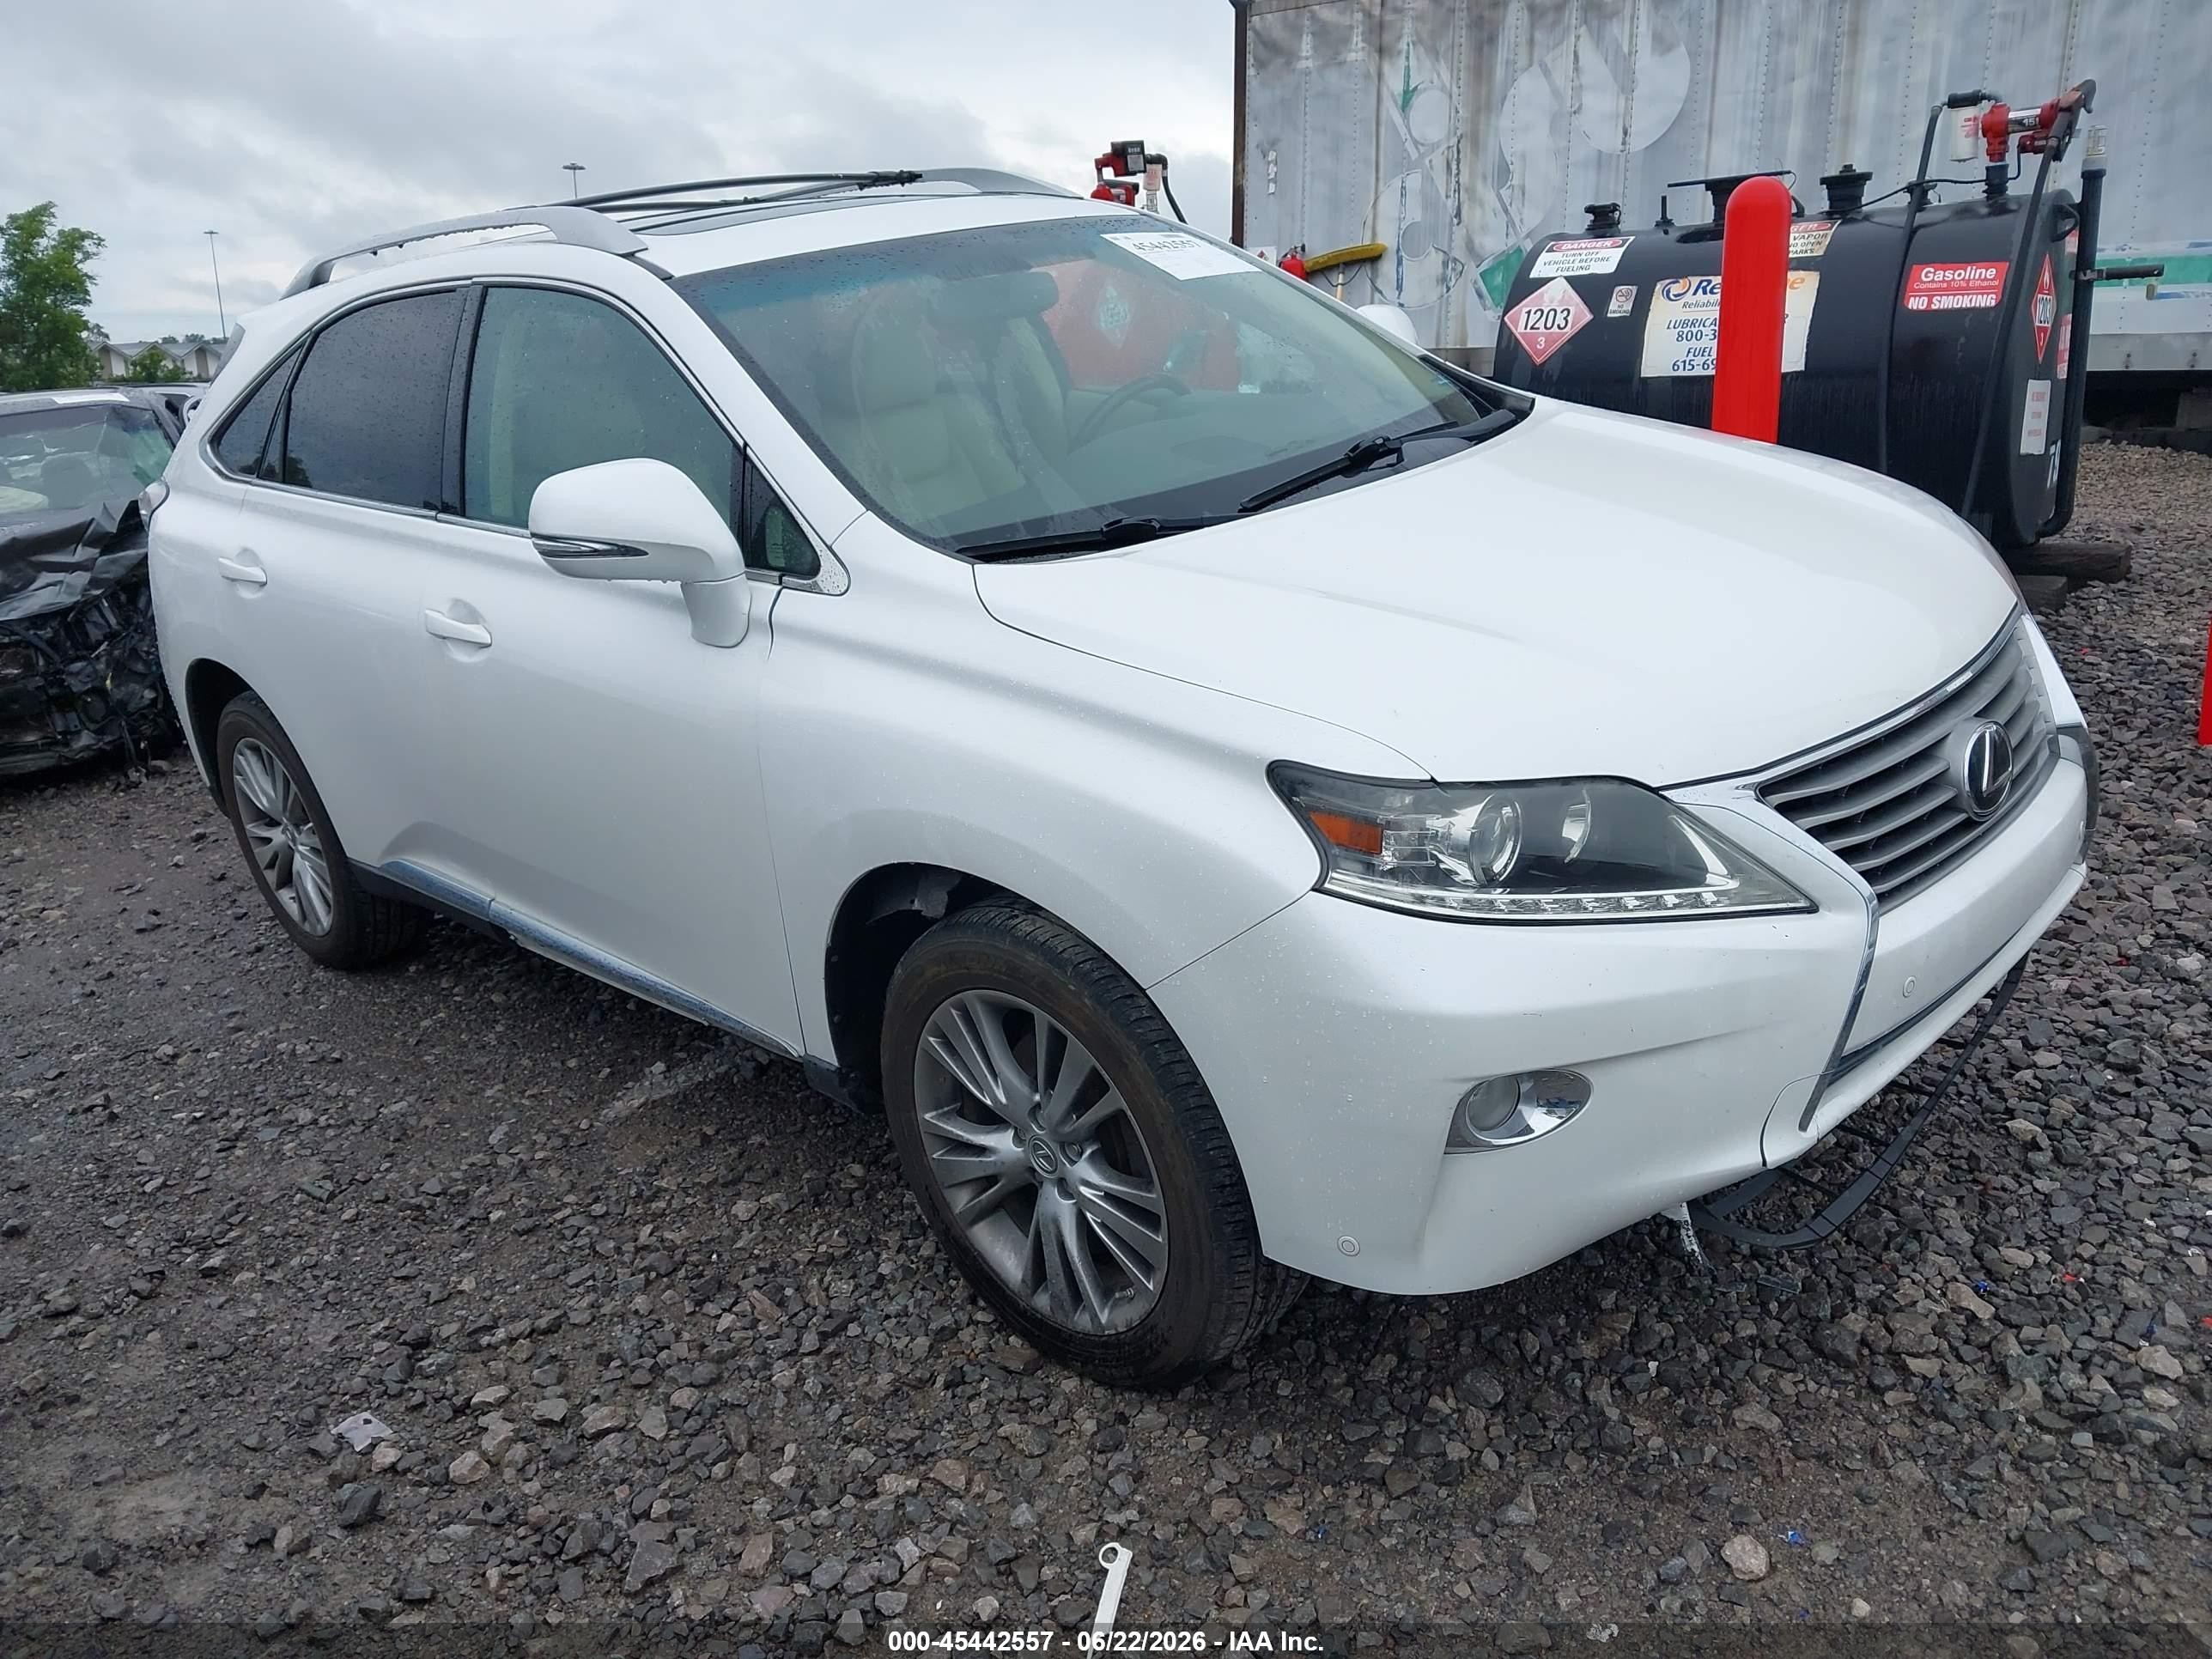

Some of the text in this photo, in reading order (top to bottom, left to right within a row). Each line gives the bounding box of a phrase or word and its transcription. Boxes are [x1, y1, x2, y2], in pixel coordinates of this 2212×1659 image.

[1561, 240, 1612, 250] DANGER
[1555, 264, 1591, 273] FUELING
[1920, 266, 1996, 282] Gasoline
[1913, 281, 1948, 289] Contains
[1908, 295, 1996, 310] NO SMOKING
[2038, 296, 2052, 325] 1203
[1523, 307, 1571, 331] 1203
[1666, 317, 1717, 330] LUBRICA
[1676, 329, 1717, 343] 800-3
[1536, 337, 1546, 349] 3
[1686, 347, 1713, 358] FUEL
